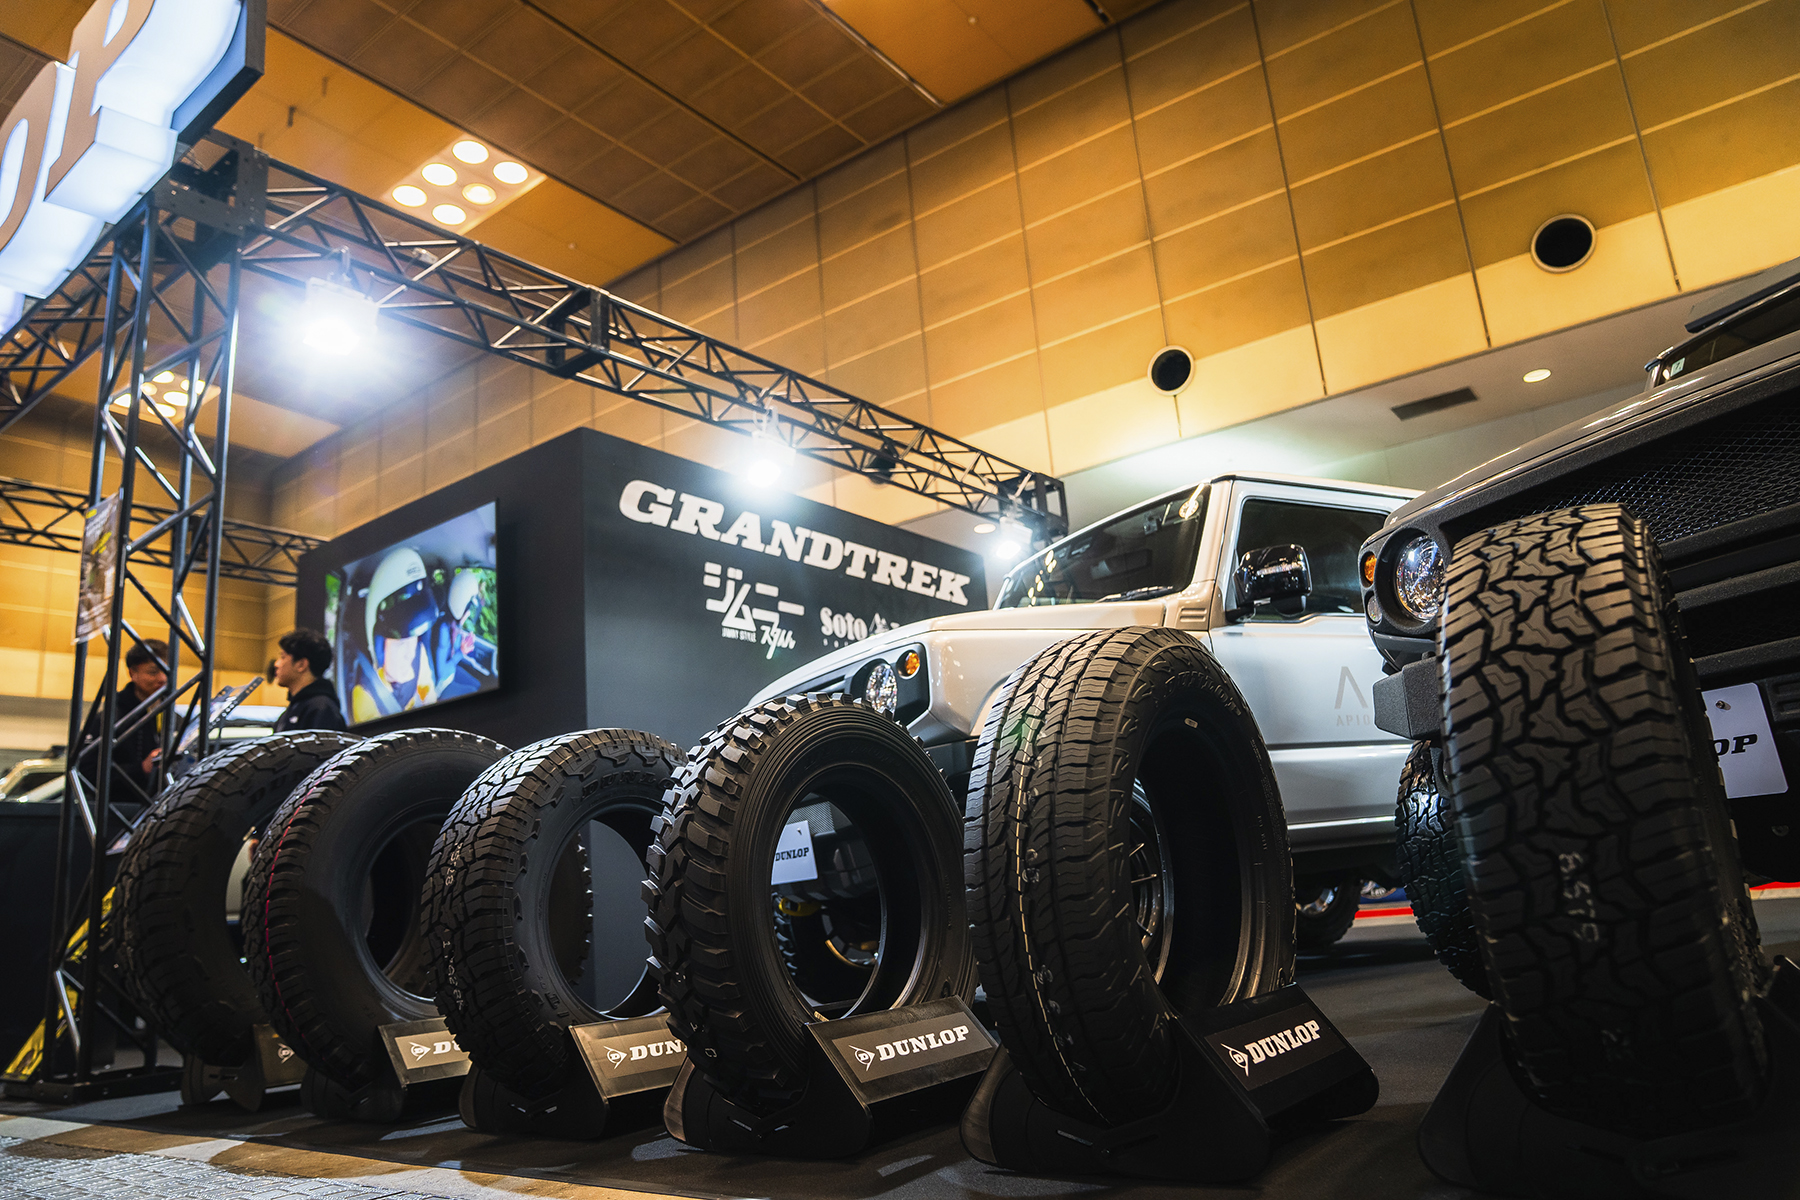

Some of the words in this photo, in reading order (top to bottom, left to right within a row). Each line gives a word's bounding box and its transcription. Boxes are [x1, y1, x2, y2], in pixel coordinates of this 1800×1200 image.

[619, 480, 971, 606] GRANDTREK
[1336, 714, 1371, 727] APIO
[775, 846, 810, 862] DUNLOP
[629, 1039, 688, 1061] DUN
[875, 1025, 970, 1062] DUNLOP
[1244, 1019, 1321, 1065] DUNLOP
